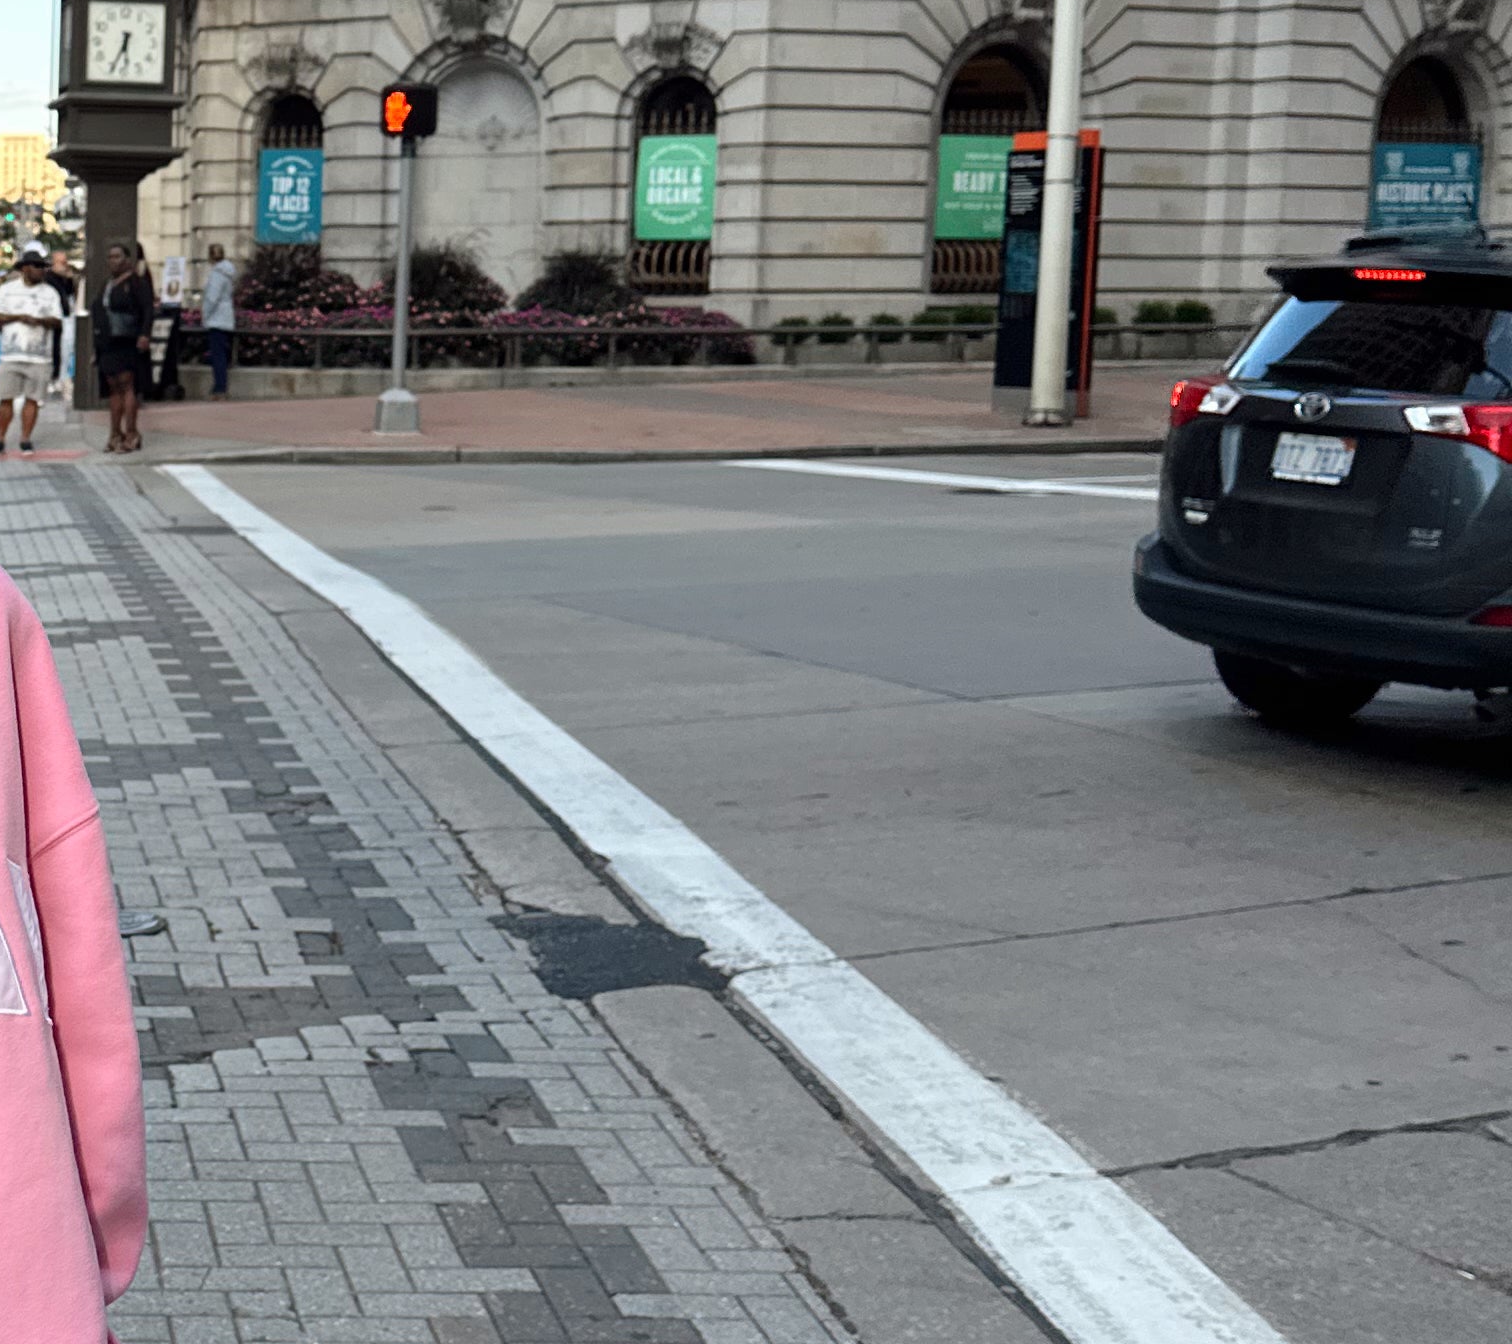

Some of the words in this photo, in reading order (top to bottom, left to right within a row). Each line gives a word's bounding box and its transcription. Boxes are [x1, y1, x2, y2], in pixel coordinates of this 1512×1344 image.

[648, 165, 689, 185] LOCAL
[952, 170, 995, 194] READY
[271, 176, 293, 194] TOP
[268, 194, 310, 213] PLACES
